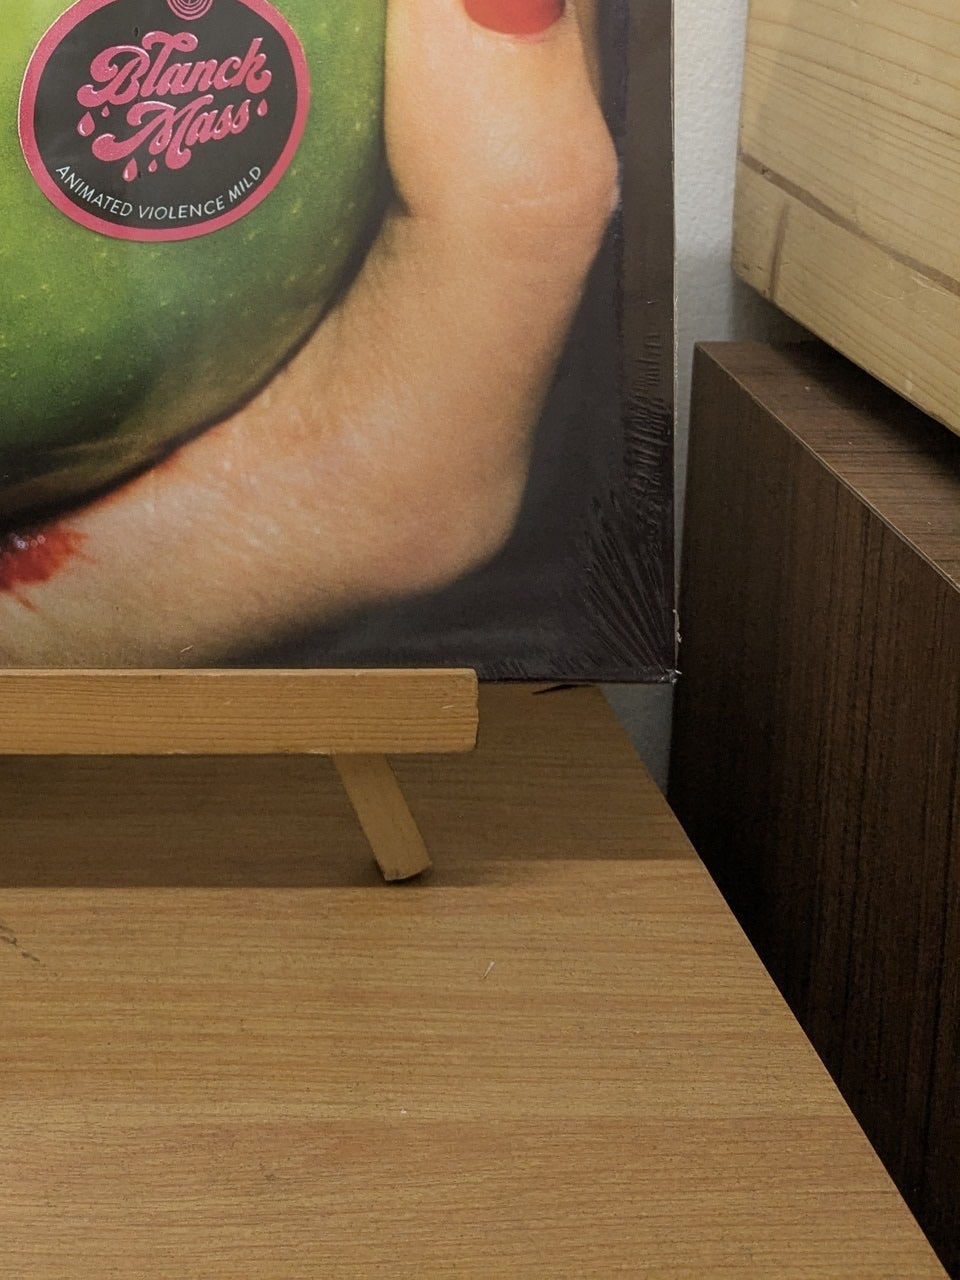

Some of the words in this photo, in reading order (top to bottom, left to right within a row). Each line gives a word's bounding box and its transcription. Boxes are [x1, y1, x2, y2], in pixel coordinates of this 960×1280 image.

[76, 30, 272, 107] Blanck
[91, 94, 251, 170] Mass
[55, 165, 133, 217] ANIMATED
[139, 195, 226, 220] VIOLENCE
[228, 166, 262, 203] MILD
